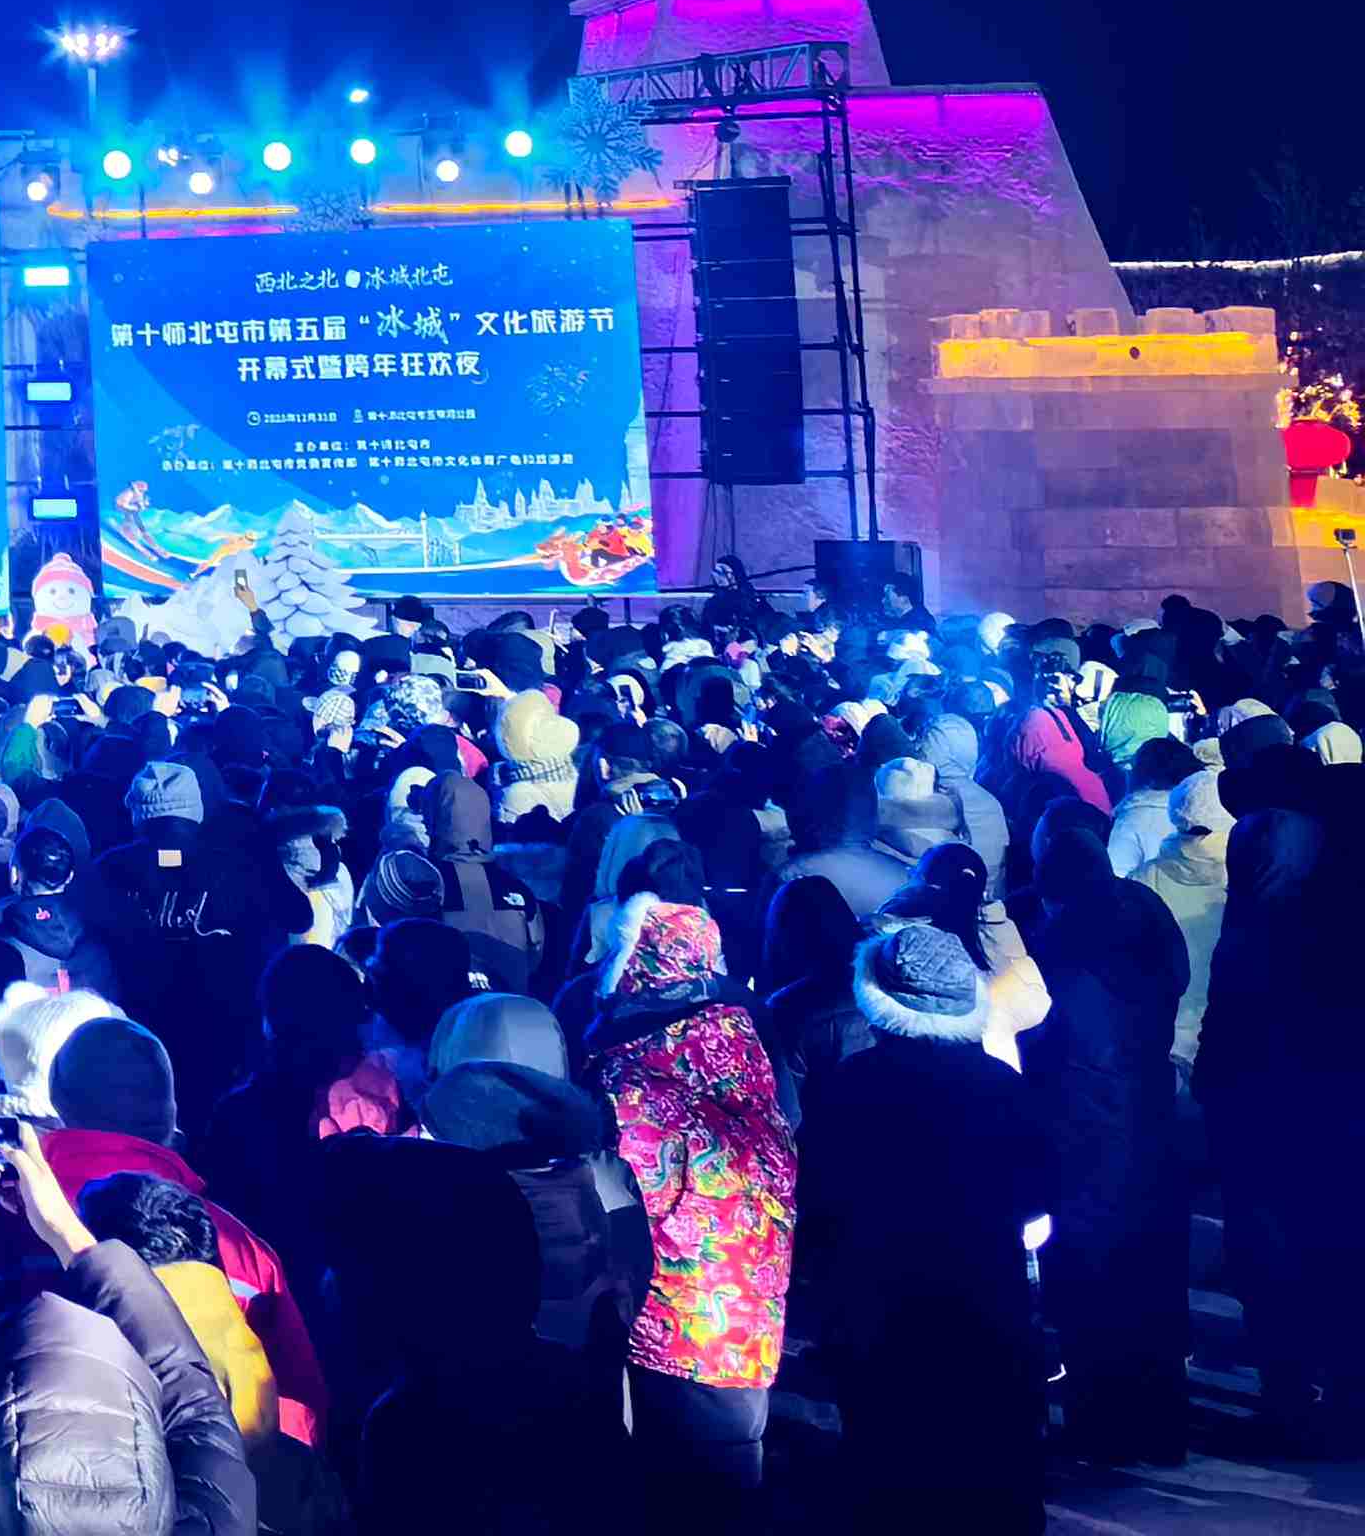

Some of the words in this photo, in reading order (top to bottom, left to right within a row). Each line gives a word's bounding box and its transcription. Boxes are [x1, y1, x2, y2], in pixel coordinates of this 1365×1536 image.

[254, 267, 340, 294] 西北之北
[364, 262, 455, 291] 冰城北屯
[236, 350, 482, 383] 开幕式暨跨年狂欢夜
